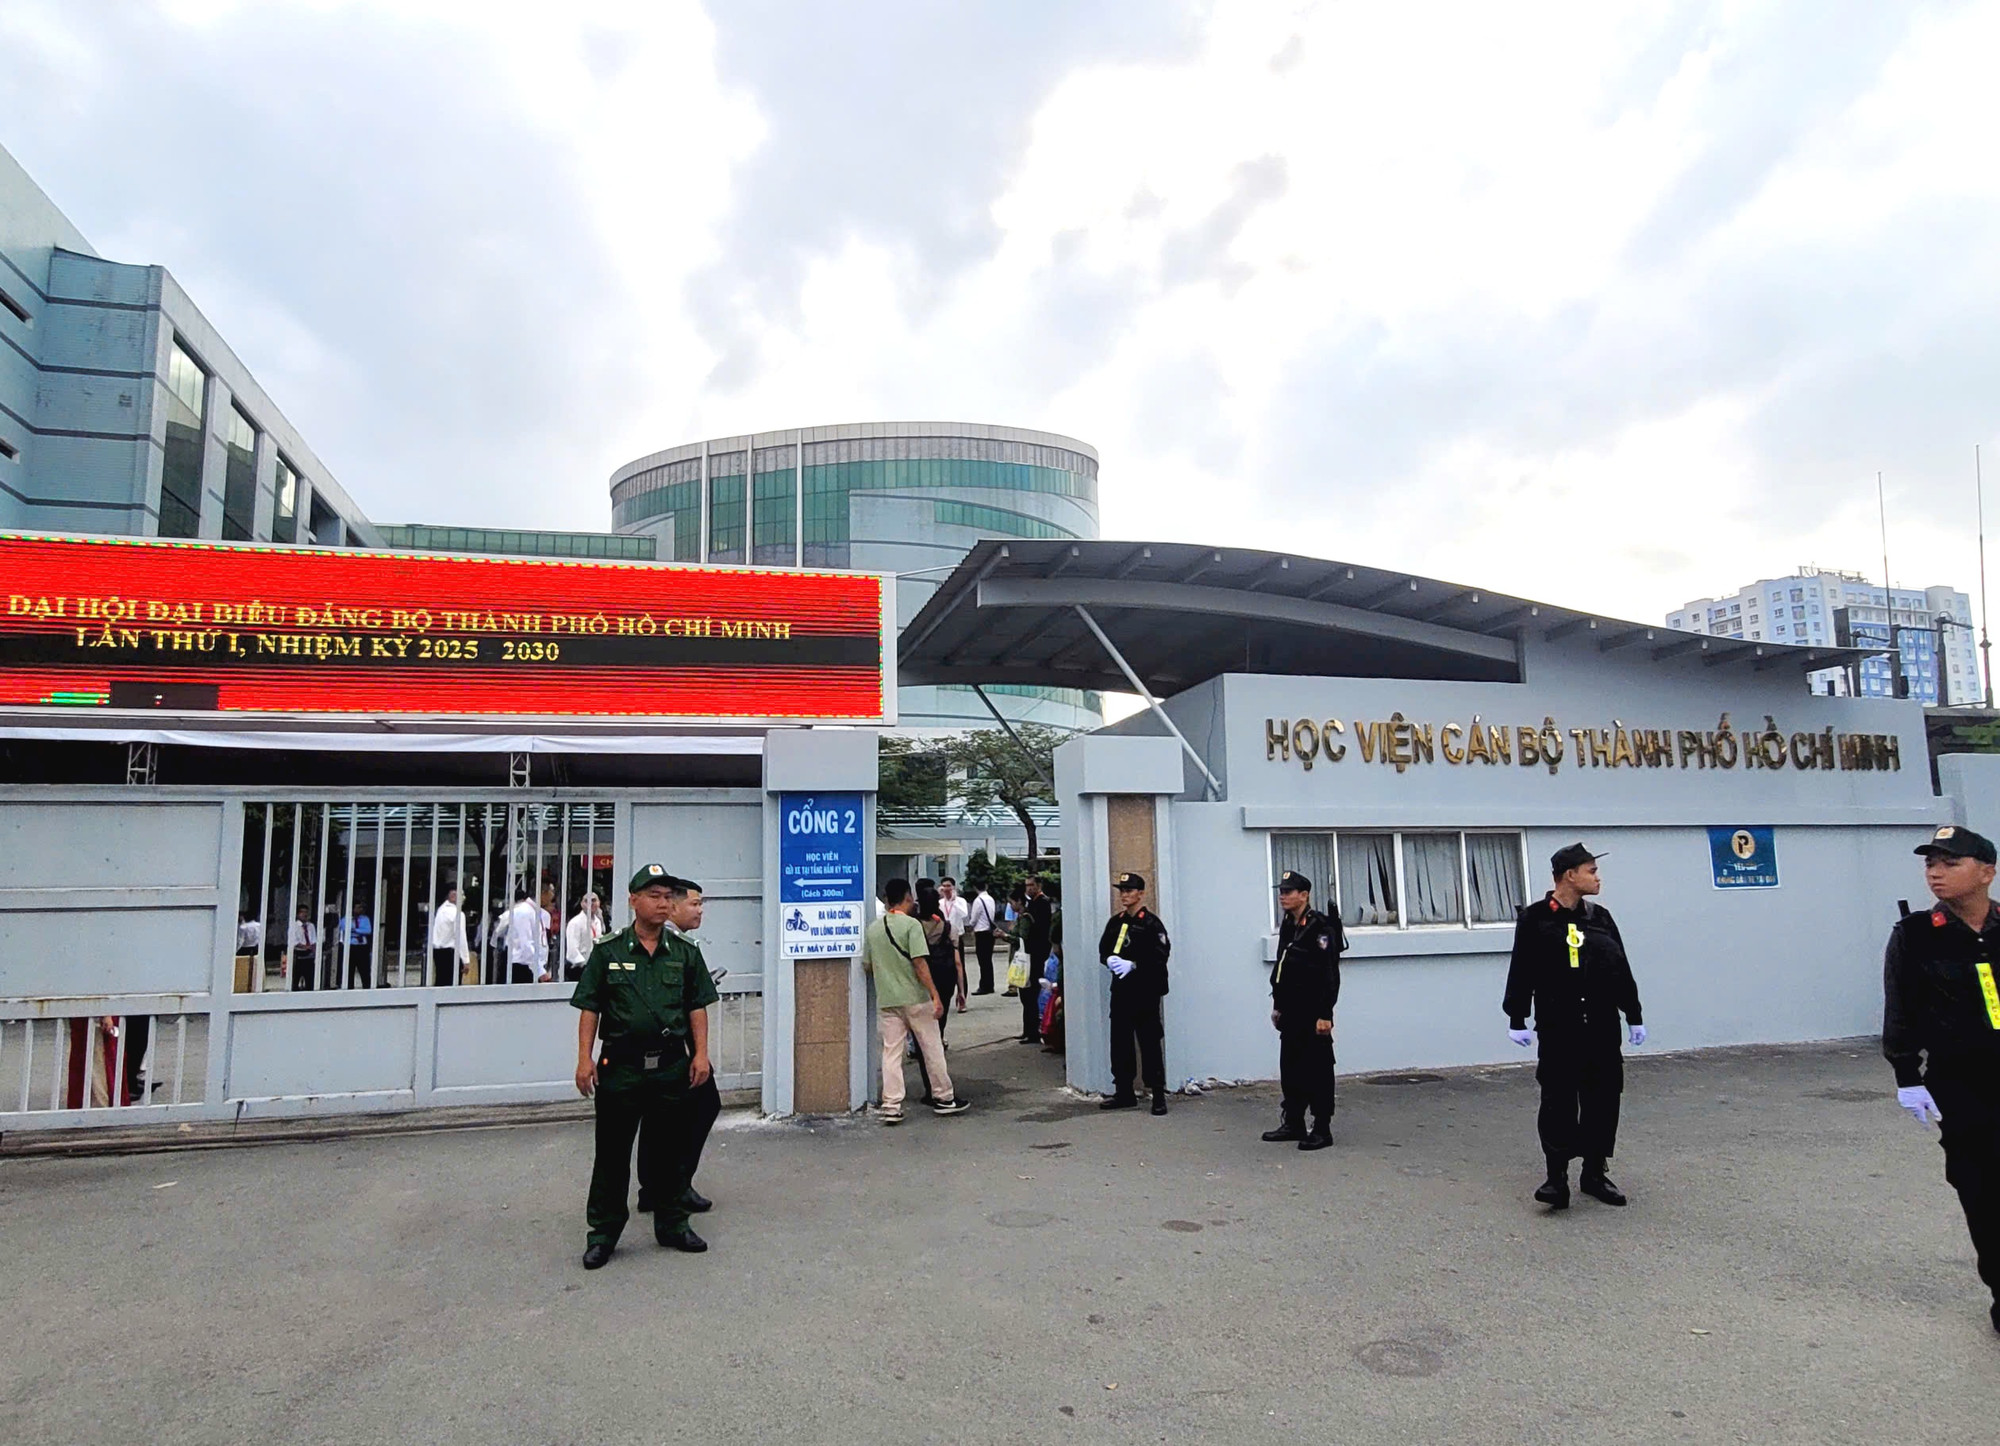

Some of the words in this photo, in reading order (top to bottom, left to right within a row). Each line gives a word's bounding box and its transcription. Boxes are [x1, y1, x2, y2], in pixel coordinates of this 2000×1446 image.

[76, 596, 138, 623] HỘI
[146, 600, 203, 625] ĐẠI
[295, 602, 383, 628] ĐẢNG
[391, 609, 433, 634] BỘ
[441, 610, 543, 633] THÀNH
[551, 612, 609, 635] PHỐ
[617, 613, 657, 636] HỒ
[664, 616, 711, 638] CHÍ
[720, 620, 792, 640] MINH
[76, 623, 141, 649] LẦN
[151, 628, 221, 652] THỨ
[229, 633, 246, 658] I,
[256, 633, 362, 660] NHIỆM
[370, 634, 413, 658] KỲ
[418, 639, 479, 660] 2025
[502, 641, 560, 662] 2030
[1265, 718, 1346, 771] HỌC
[1354, 712, 1434, 773] VIỆN
[1440, 714, 1512, 765] CÁN
[1517, 716, 1564, 775] BỘ
[1569, 719, 1674, 768] THÀNH
[1678, 712, 1738, 769] PHỐ
[1744, 715, 1787, 770] HỒ
[1791, 725, 1835, 771] CHÍ
[1839, 733, 1901, 772] MINH
[788, 798, 839, 834] CỔNG
[844, 810, 856, 834] 2
[806, 853, 821, 862] HỌC
[801, 889, 821, 898] (Cách
[822, 889, 844, 897] 300m)
[818, 911, 826, 920] RA
[827, 909, 837, 919] VÀO
[811, 927, 819, 936] VUI
[853, 926, 859, 934] XE
[807, 944, 824, 952] MÁY
[845, 943, 856, 952] BỘ
